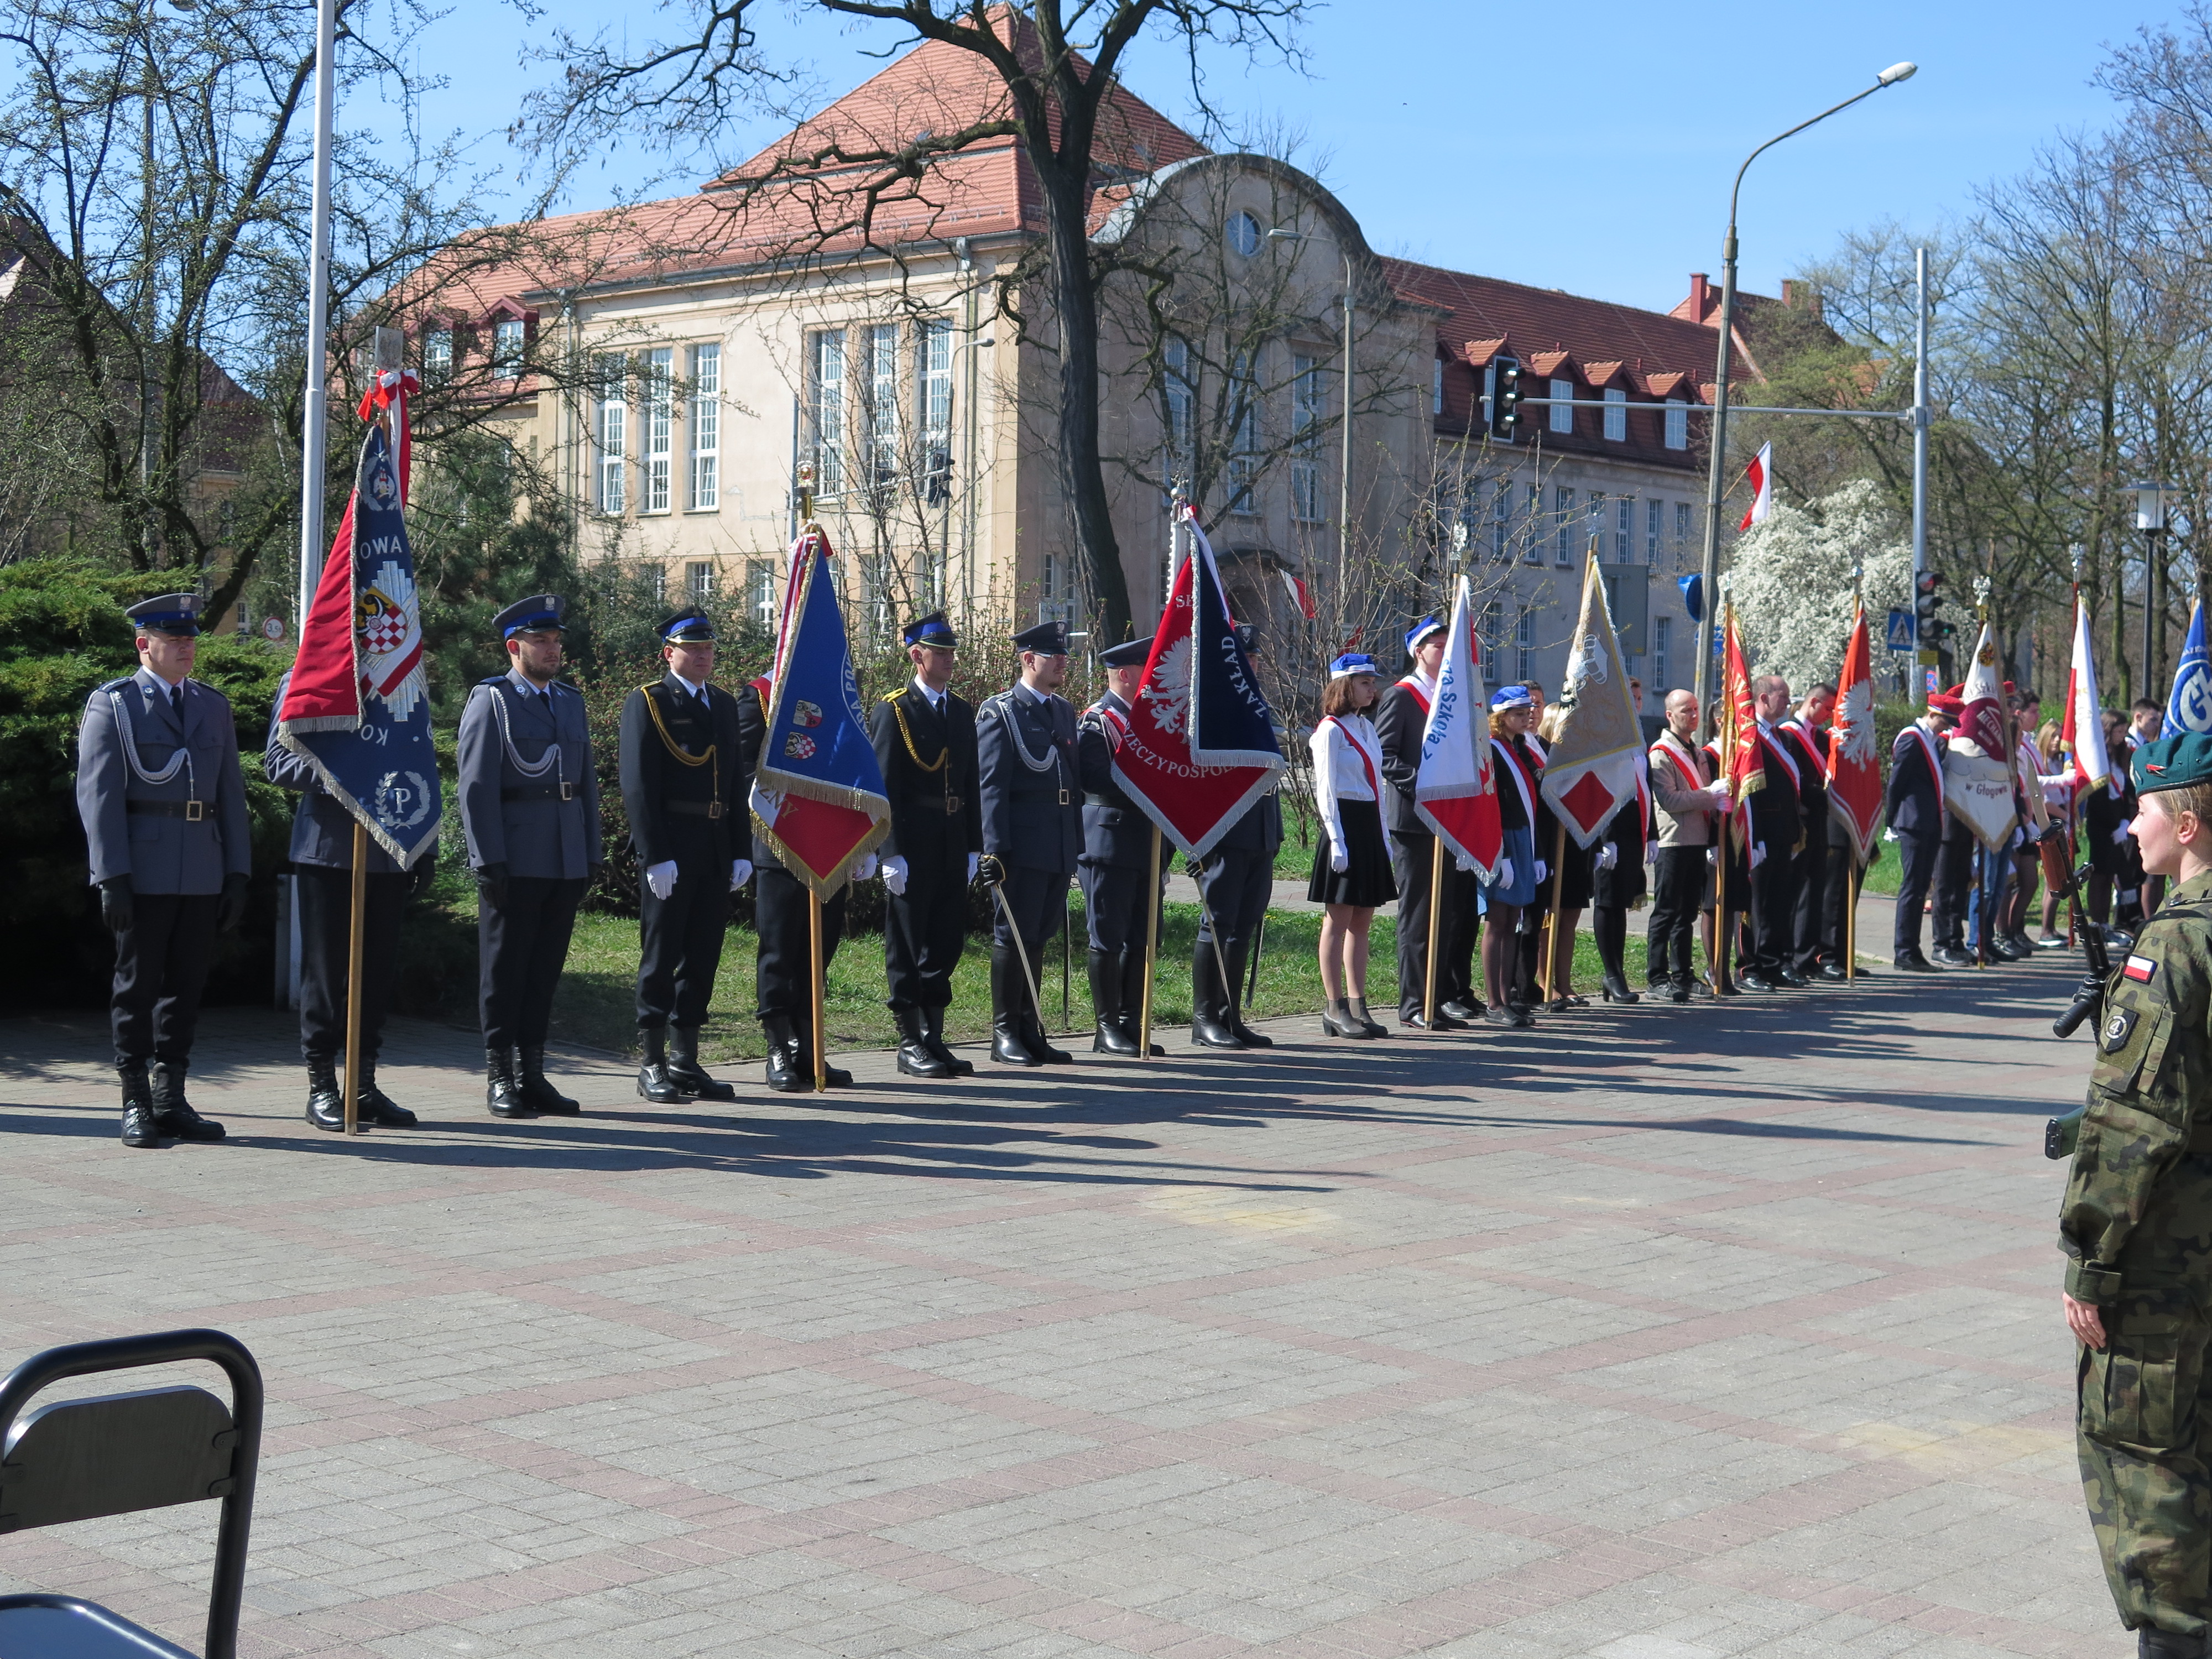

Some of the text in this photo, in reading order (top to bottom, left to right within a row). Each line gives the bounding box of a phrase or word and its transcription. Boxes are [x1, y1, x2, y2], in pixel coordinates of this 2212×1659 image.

[1176, 594, 1193, 608] SŁ
[1222, 637, 1267, 718] ZAKŁAD
[1427, 693, 1457, 744] Szkoła
[1976, 710, 2005, 749] MECHAN
[1124, 721, 1240, 778] RZECZYPOSPOL
[393, 787, 411, 813] P
